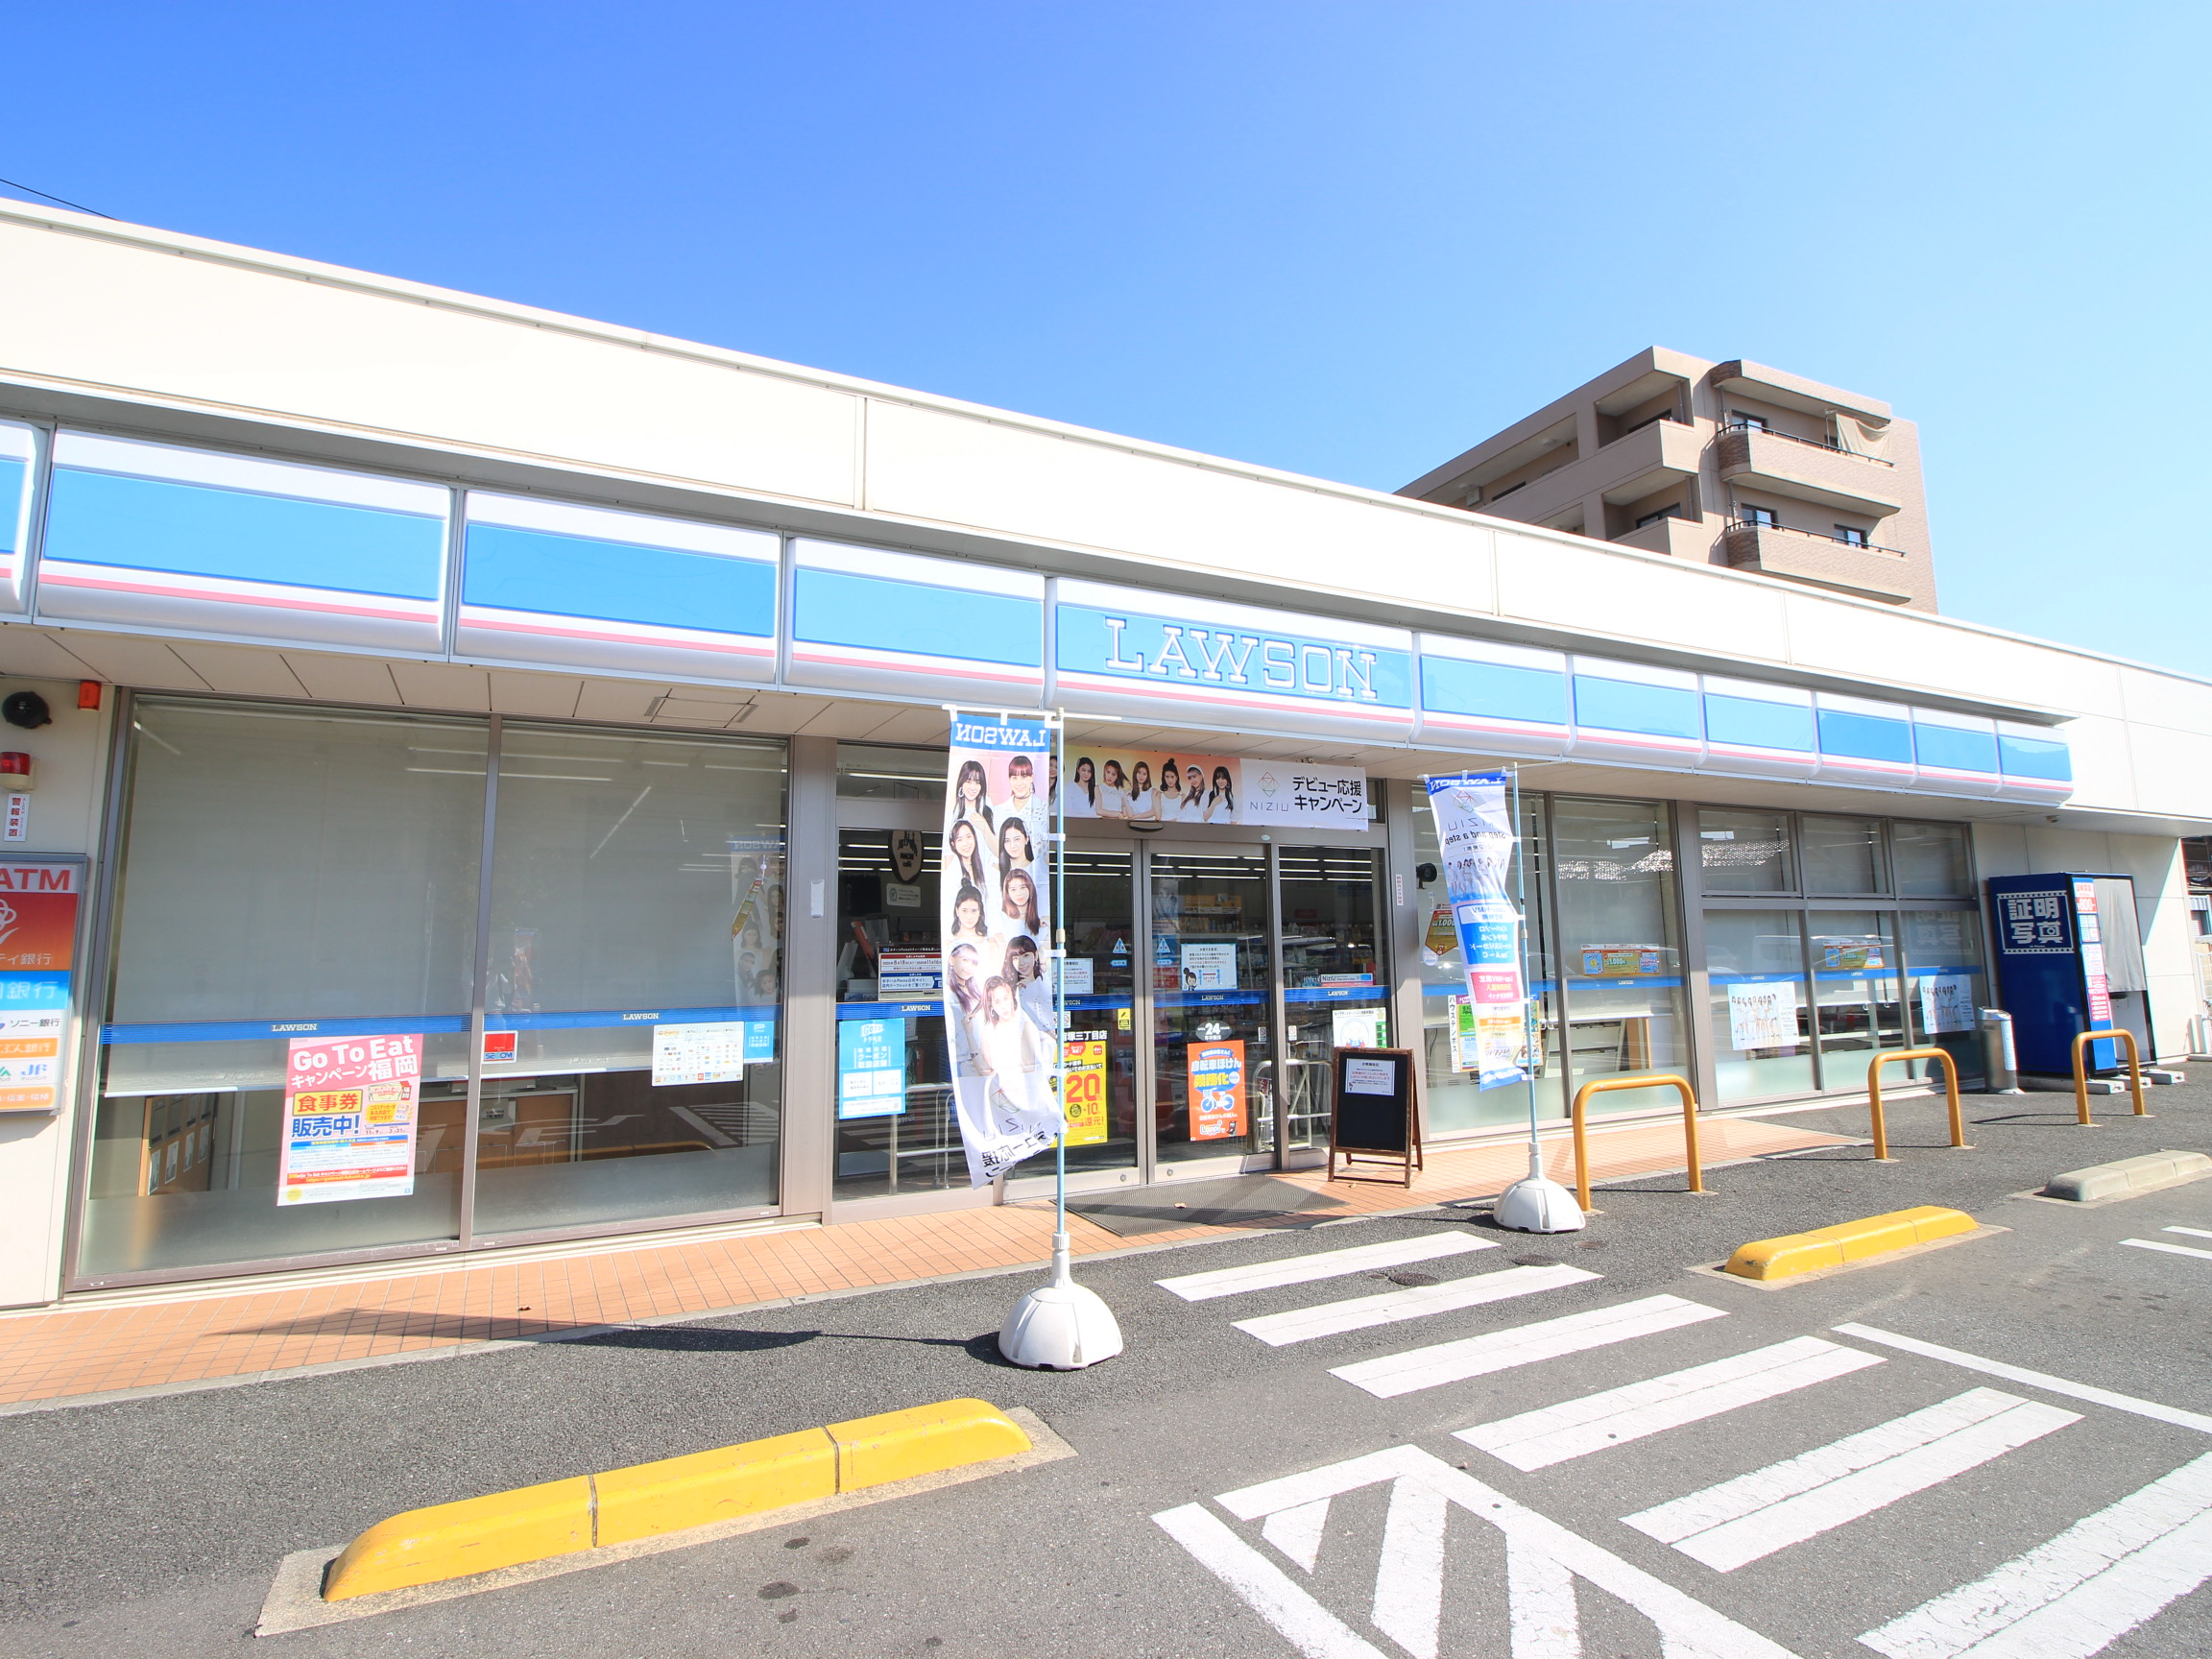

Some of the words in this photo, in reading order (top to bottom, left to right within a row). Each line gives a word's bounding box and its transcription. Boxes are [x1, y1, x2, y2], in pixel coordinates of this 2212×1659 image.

[1105, 616, 1378, 699] LAWSON
[1292, 776, 1362, 797] デビュー応援
[1249, 801, 1289, 812] NIZIU
[1294, 795, 1362, 813] キャンペーン
[2008, 897, 2060, 920] 証明
[2010, 921, 2063, 944] 写真
[0, 981, 59, 999] 銀行
[11, 1018, 60, 1028] ソニー銀行
[272, 1023, 318, 1032] LAWSON
[1204, 1022, 1221, 1035] 24
[1449, 997, 1458, 1052] ハウステンボス
[293, 1050, 328, 1071] Go
[332, 1044, 365, 1066] To
[370, 1036, 414, 1059] Eat
[485, 1051, 513, 1060] SECOM
[291, 1054, 419, 1089] キャンペーン福岡
[1191, 1058, 1241, 1072] 自転車ほけん
[298, 1093, 358, 1113] 食事券
[292, 1115, 361, 1138] 販売中!
